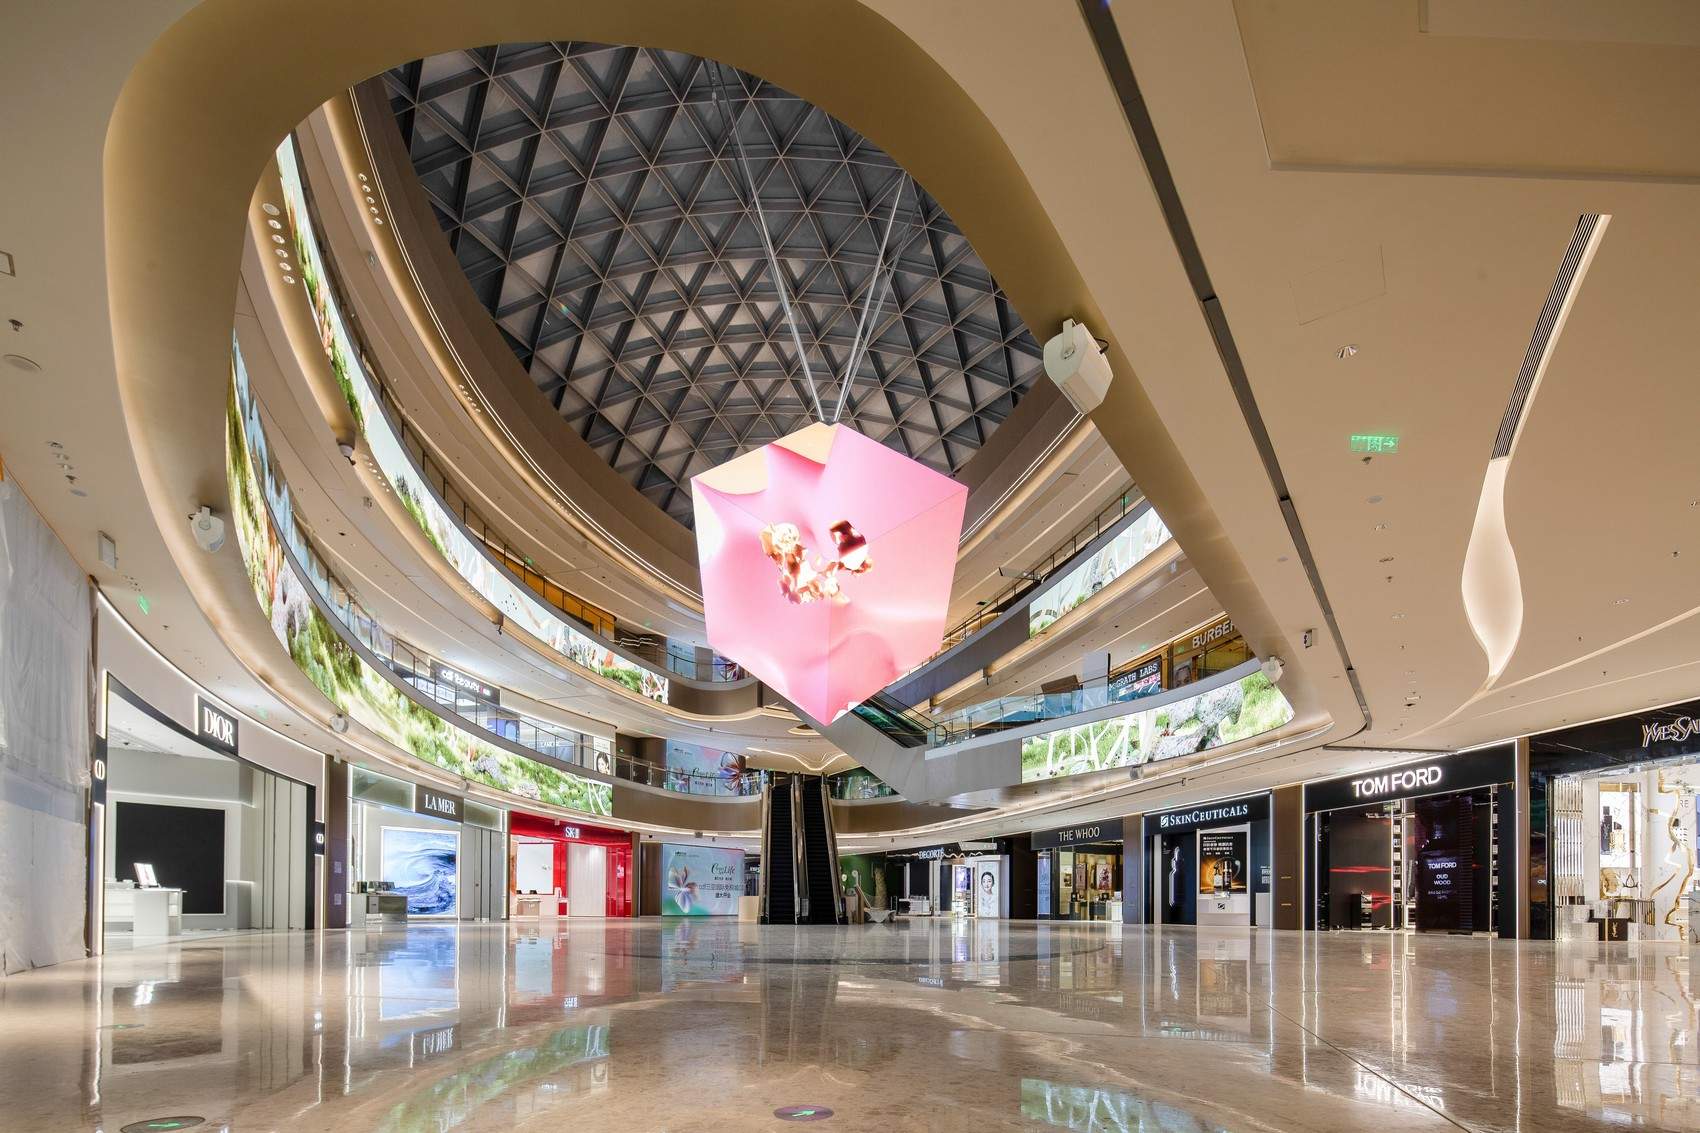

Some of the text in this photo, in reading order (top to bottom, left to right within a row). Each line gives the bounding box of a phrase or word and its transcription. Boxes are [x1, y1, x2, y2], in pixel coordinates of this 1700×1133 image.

[1140, 663, 1158, 678] LABS
[203, 706, 235, 747] DIOR
[1351, 766, 1442, 798] TOM FORD
[425, 794, 456, 815] LA MER
[1058, 826, 1100, 842] THE WHOO
[1428, 861, 1457, 870] TOM FORD
